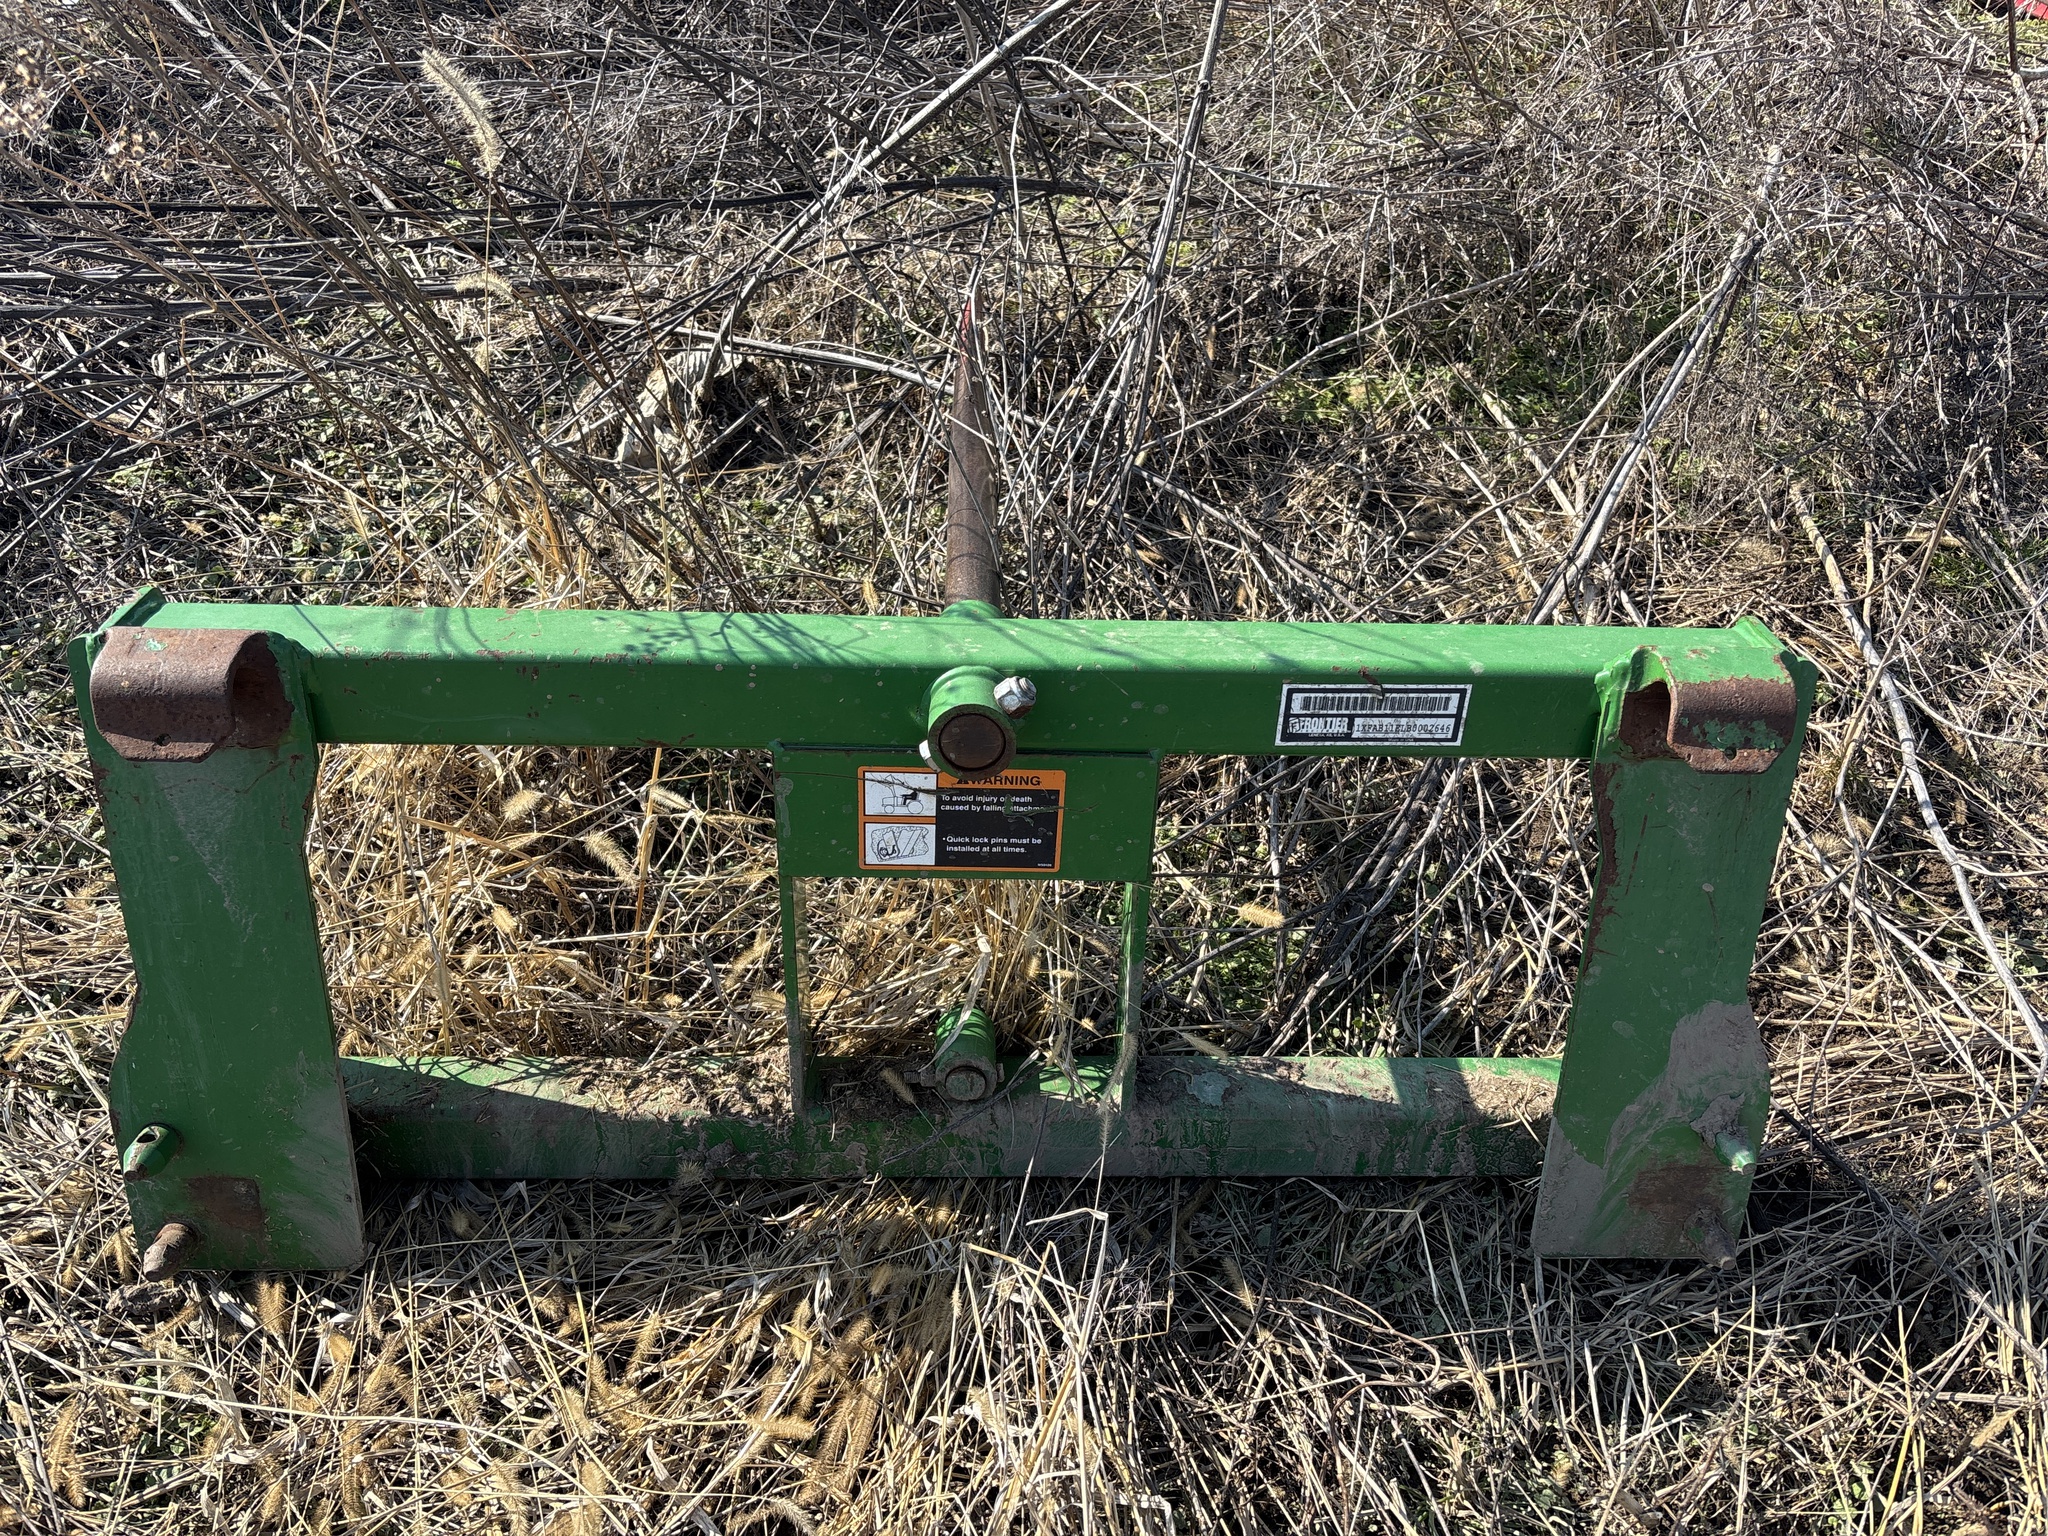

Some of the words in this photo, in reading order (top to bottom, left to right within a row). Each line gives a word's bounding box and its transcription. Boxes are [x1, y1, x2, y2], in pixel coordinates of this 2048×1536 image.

[1299, 717, 1349, 733] FRONTIER
[975, 795, 997, 804] injury
[1010, 795, 1032, 803] death
[971, 804, 981, 812] by
[990, 837, 1008, 845] pins
